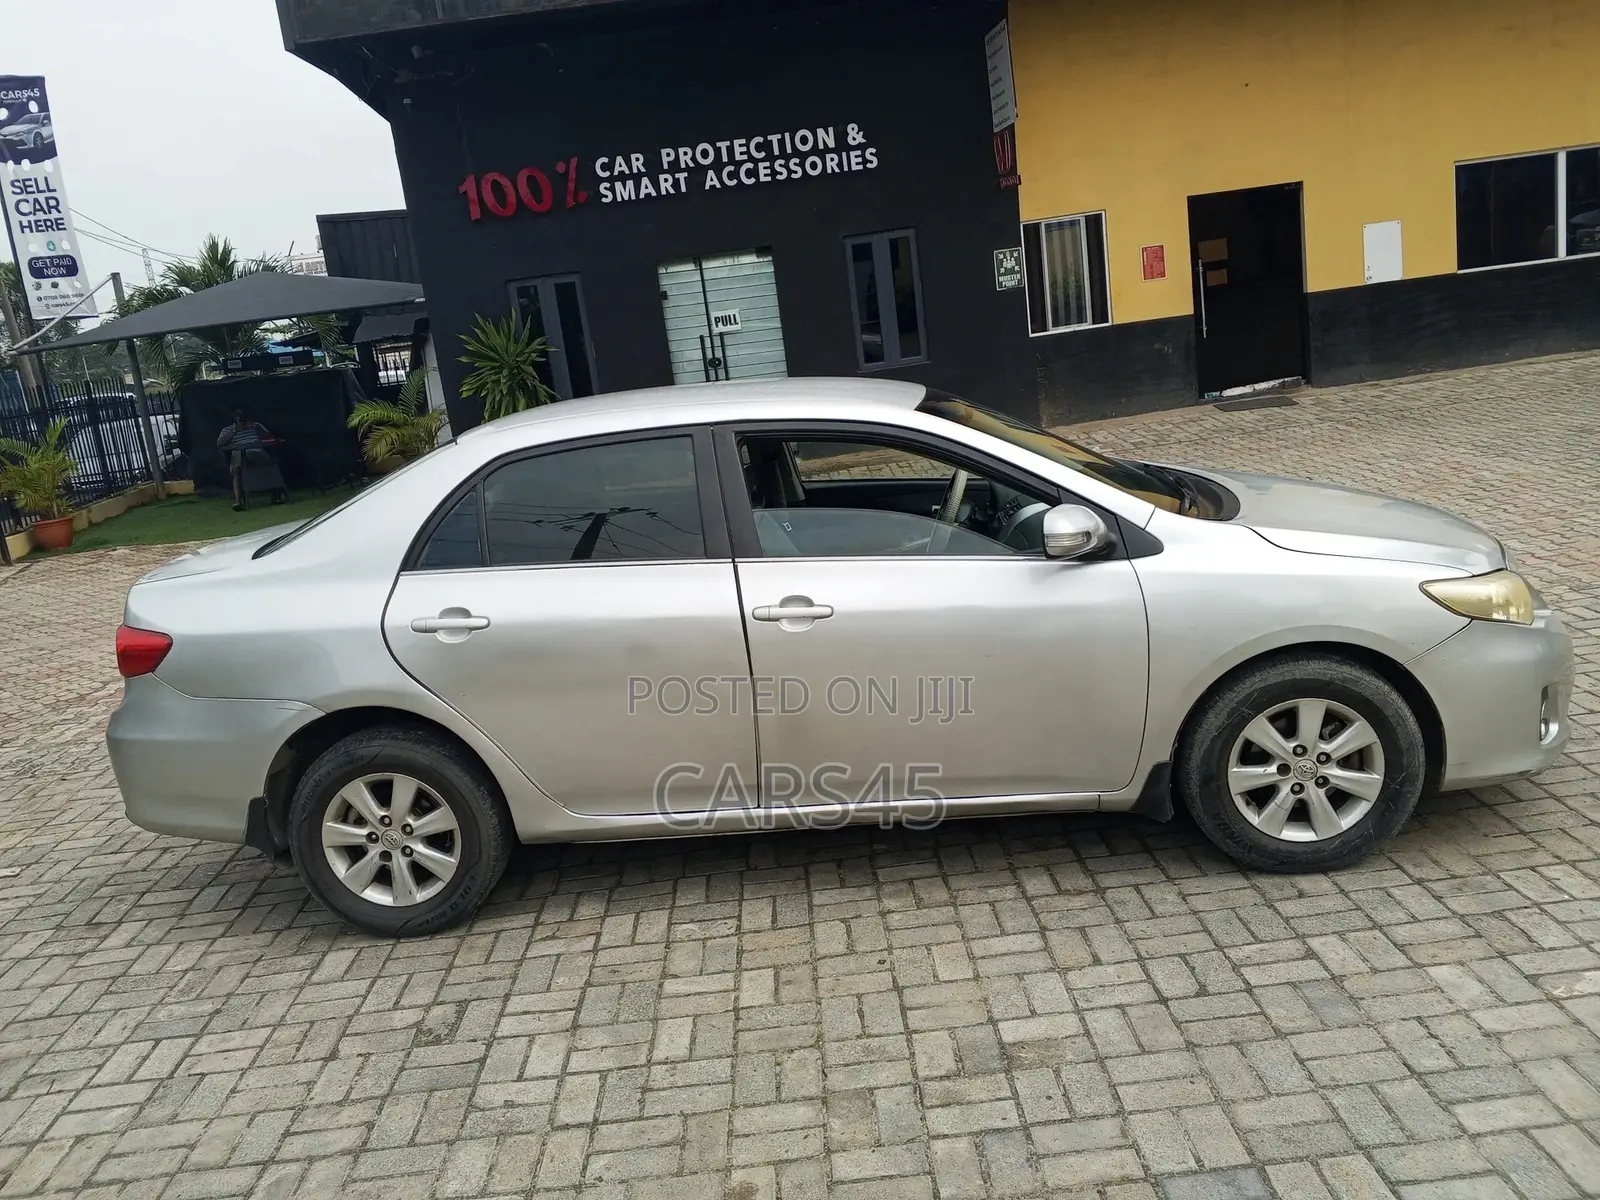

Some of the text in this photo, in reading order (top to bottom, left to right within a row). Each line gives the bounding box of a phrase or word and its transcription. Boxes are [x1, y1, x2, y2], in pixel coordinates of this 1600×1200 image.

[595, 122, 867, 178] CAR PROTECTION &
[599, 147, 878, 203] SMART ACCESSORIES
[10, 176, 57, 195] SELL
[458, 156, 588, 221] 100%
[14, 196, 62, 216] CAR
[18, 217, 67, 234] HERE
[32, 257, 72, 268] GET PAID
[43, 267, 67, 276] NOW
[999, 274, 1021, 282] MUSTER
[714, 313, 739, 328] PULL
